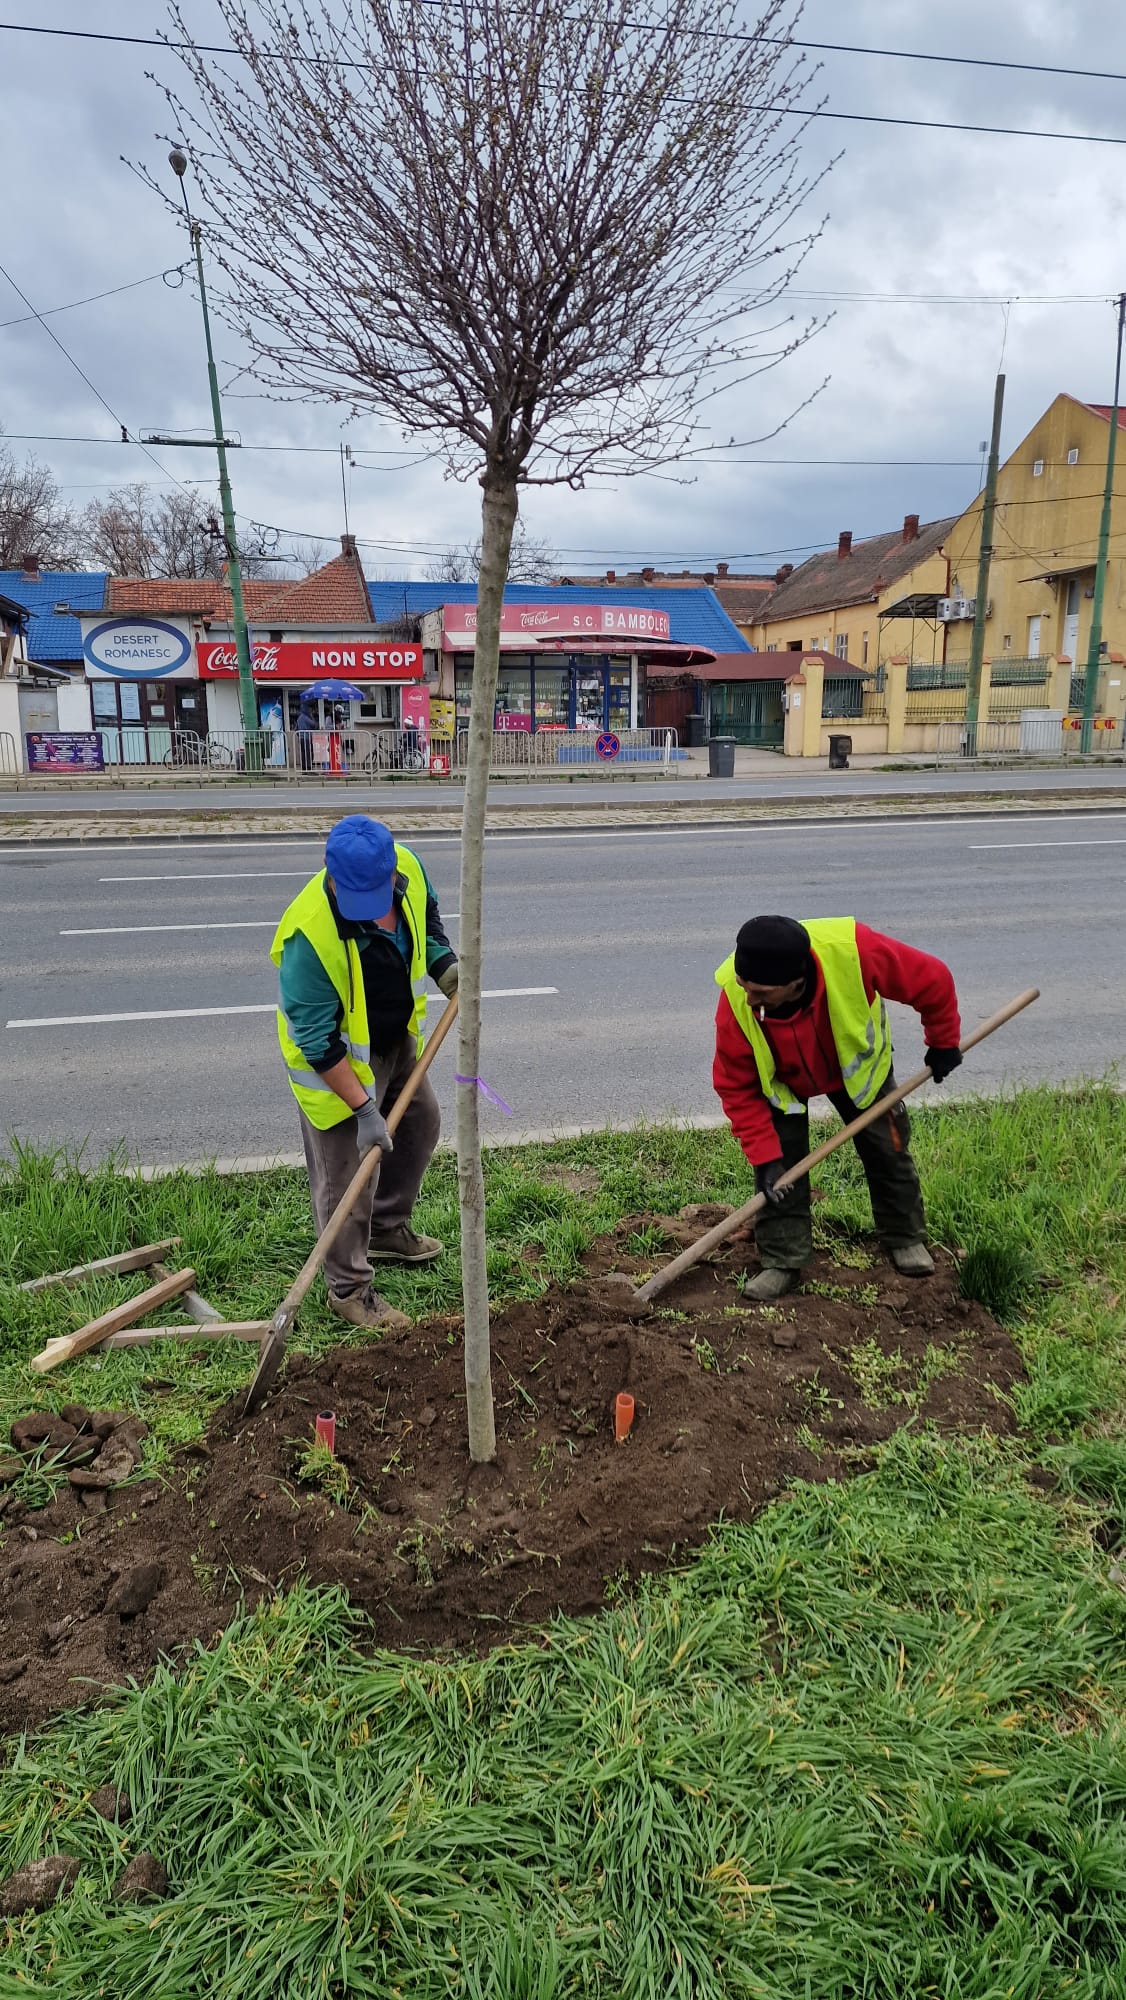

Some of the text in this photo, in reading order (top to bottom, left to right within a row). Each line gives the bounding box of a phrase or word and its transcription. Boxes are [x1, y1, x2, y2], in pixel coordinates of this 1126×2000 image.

[113, 635, 159, 645] DESERT
[104, 649, 171, 658] ROMANESC
[312, 651, 417, 667] NON STOP
